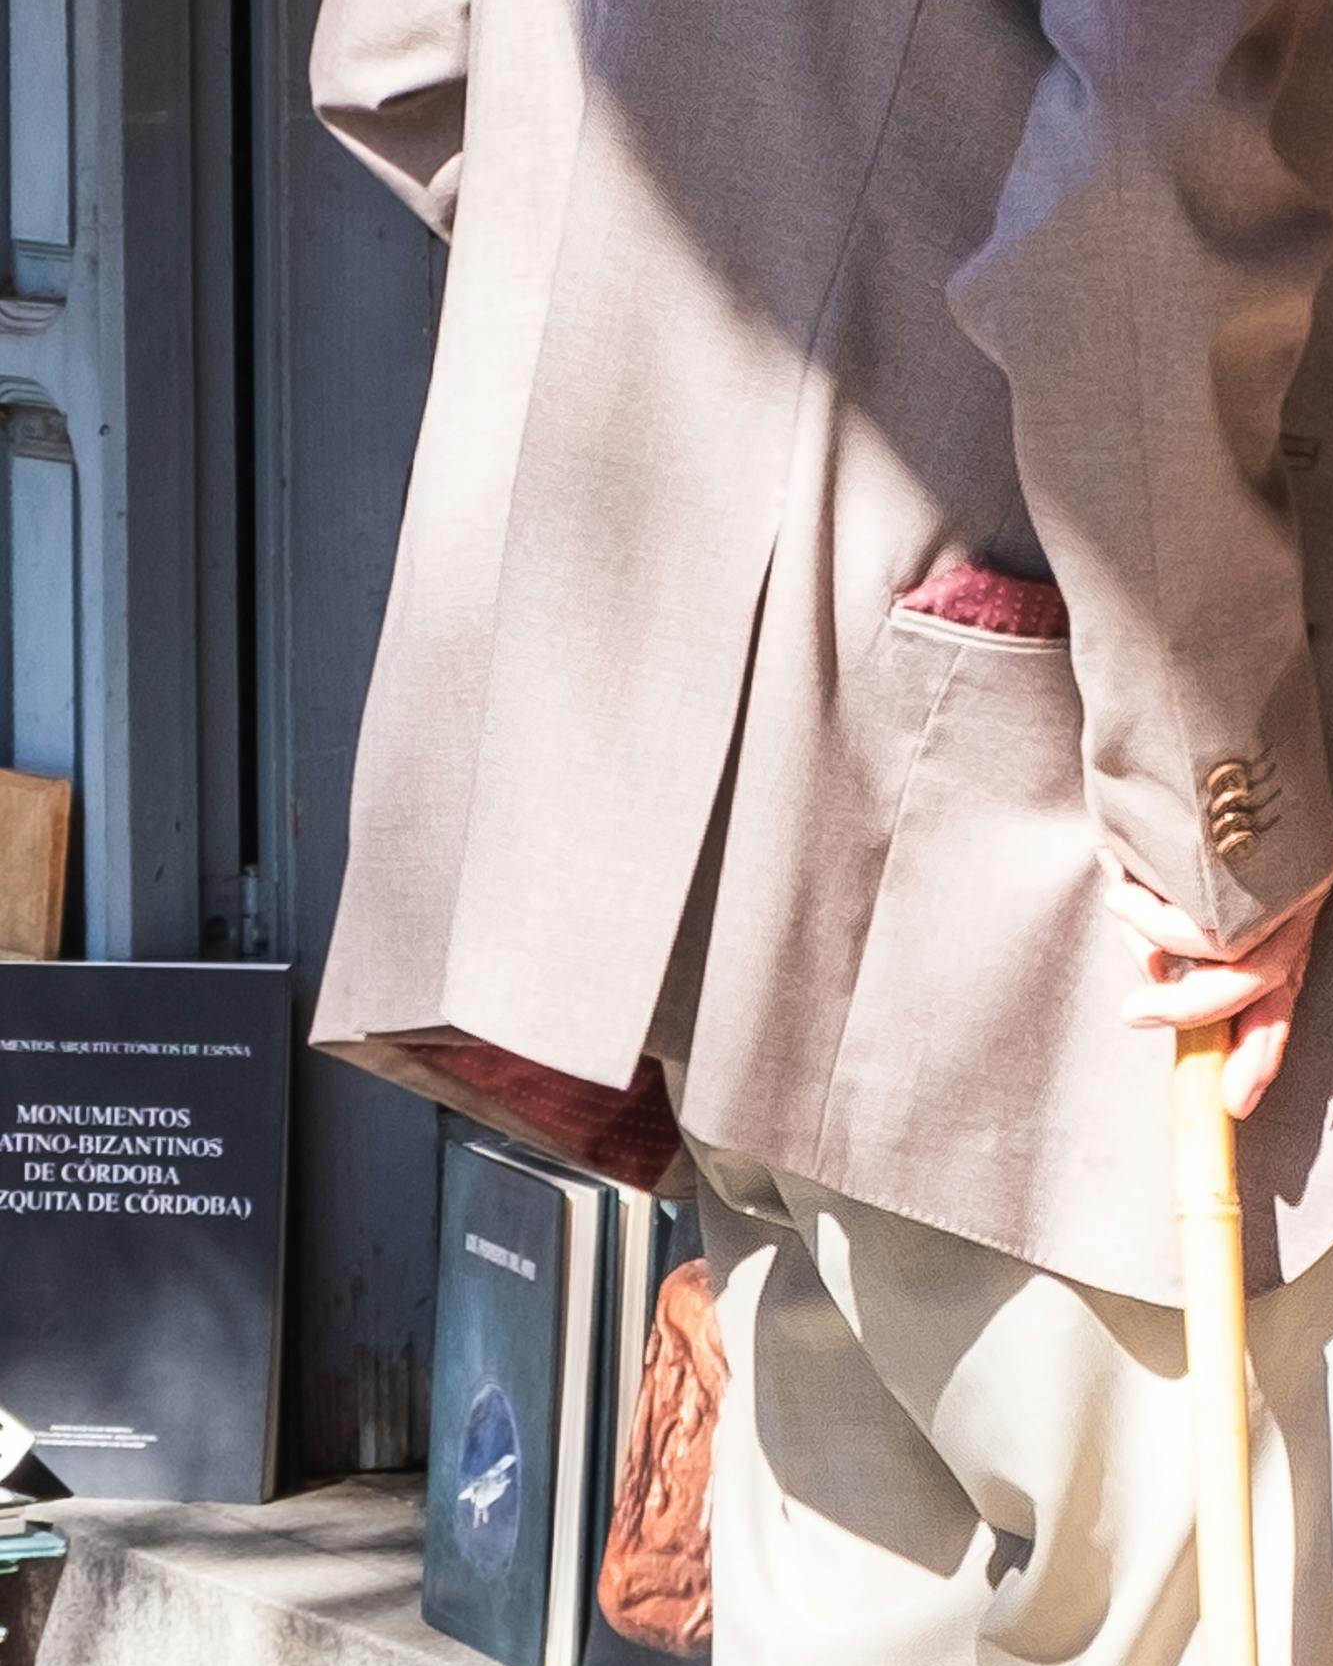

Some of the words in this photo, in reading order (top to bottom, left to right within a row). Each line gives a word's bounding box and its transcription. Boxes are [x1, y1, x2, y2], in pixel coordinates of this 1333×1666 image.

[16, 1104, 192, 1129] MONUMENTOS
[24, 1162, 55, 1182] DE
[61, 1158, 181, 1186] CÓRDOBA
[87, 1192, 121, 1213] DE
[125, 1189, 252, 1220] CÓRDOBA)
